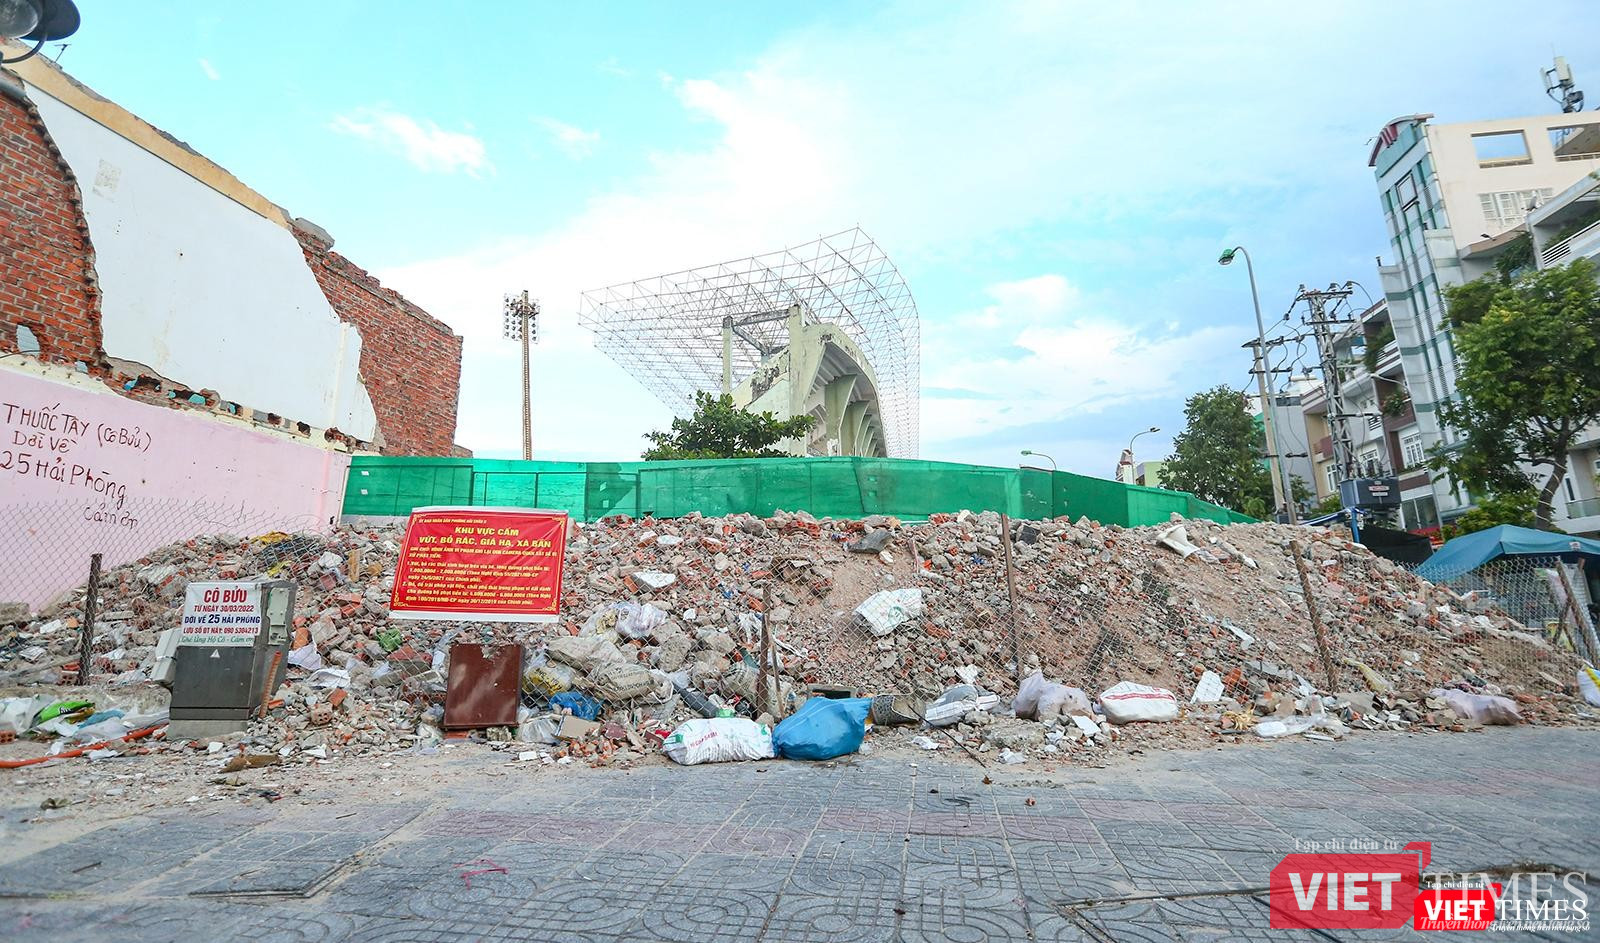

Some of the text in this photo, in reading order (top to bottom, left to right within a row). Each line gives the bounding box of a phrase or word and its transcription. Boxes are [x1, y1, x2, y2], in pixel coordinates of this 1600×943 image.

[2, 402, 60, 432] THUỐC
[62, 413, 90, 436] TÂY
[0, 450, 32, 474] 25
[36, 456, 66, 482] Hải
[476, 528, 495, 536] VỰC
[498, 527, 519, 536] CẤM
[440, 535, 453, 544] BỎ
[204, 586, 248, 603] CÔ BỬU
[208, 614, 220, 624] 25
[221, 615, 234, 624] HẢI
